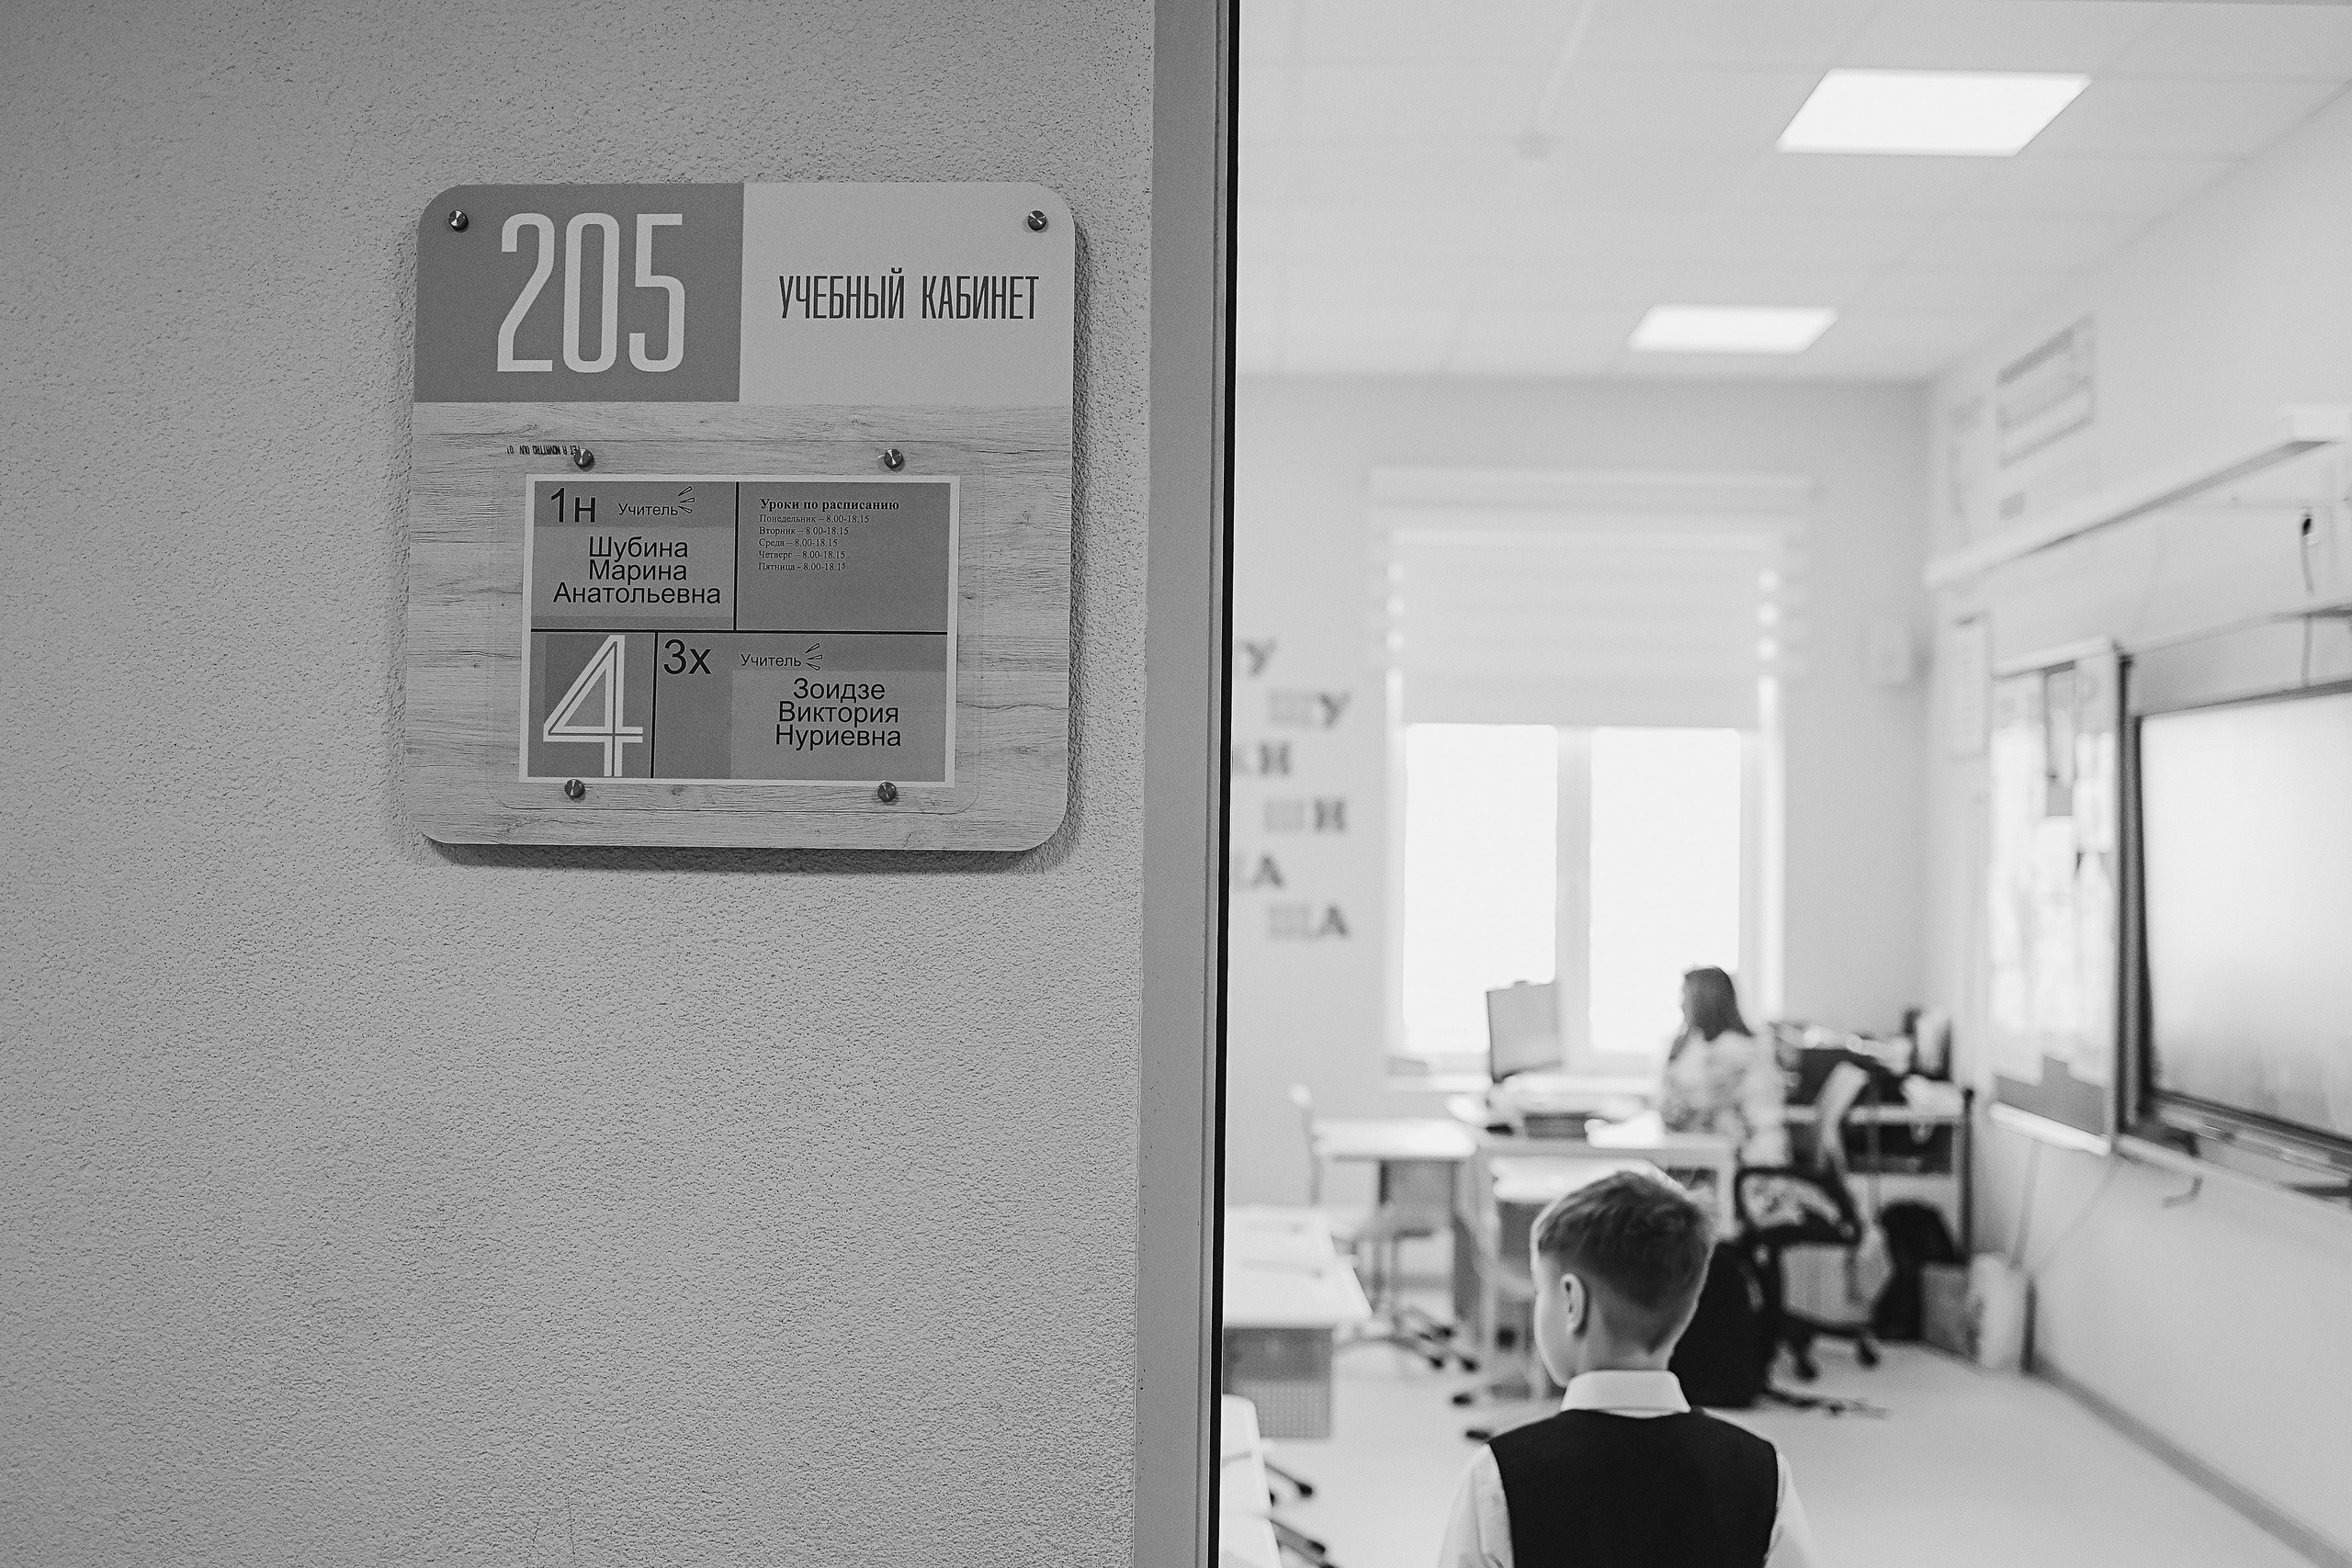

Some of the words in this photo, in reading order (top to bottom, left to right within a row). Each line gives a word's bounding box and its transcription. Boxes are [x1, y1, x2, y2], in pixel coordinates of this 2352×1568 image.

[497, 212, 686, 373] 205
[779, 267, 905, 320] УЧЕБНЫЙ
[921, 276, 1040, 320] КАБИНЕТ
[550, 487, 596, 523] 1н
[617, 503, 679, 516] Учитель
[760, 499, 799, 512] Уроки
[821, 502, 899, 512] расписанию
[759, 514, 817, 524] Понедельник
[826, 514, 870, 524] 8.00-18.15
[759, 526, 797, 536] Вторник
[805, 526, 849, 535] 8.00-18.15
[589, 536, 689, 562] Шубина
[759, 538, 785, 548] Среда
[794, 538, 838, 547] 8.00-18.15
[759, 551, 793, 560] Четверг
[589, 559, 687, 585] Марина
[758, 562, 796, 572] Пятница
[803, 562, 846, 570] 8.00-18.15
[552, 581, 721, 604] Анатольевна
[663, 639, 712, 676] 3х
[741, 653, 802, 668] Учитель
[793, 678, 886, 701] Зоидзе
[543, 635, 643, 777] 4
[778, 701, 899, 726] Виктория
[775, 724, 901, 750] Нуриевна
